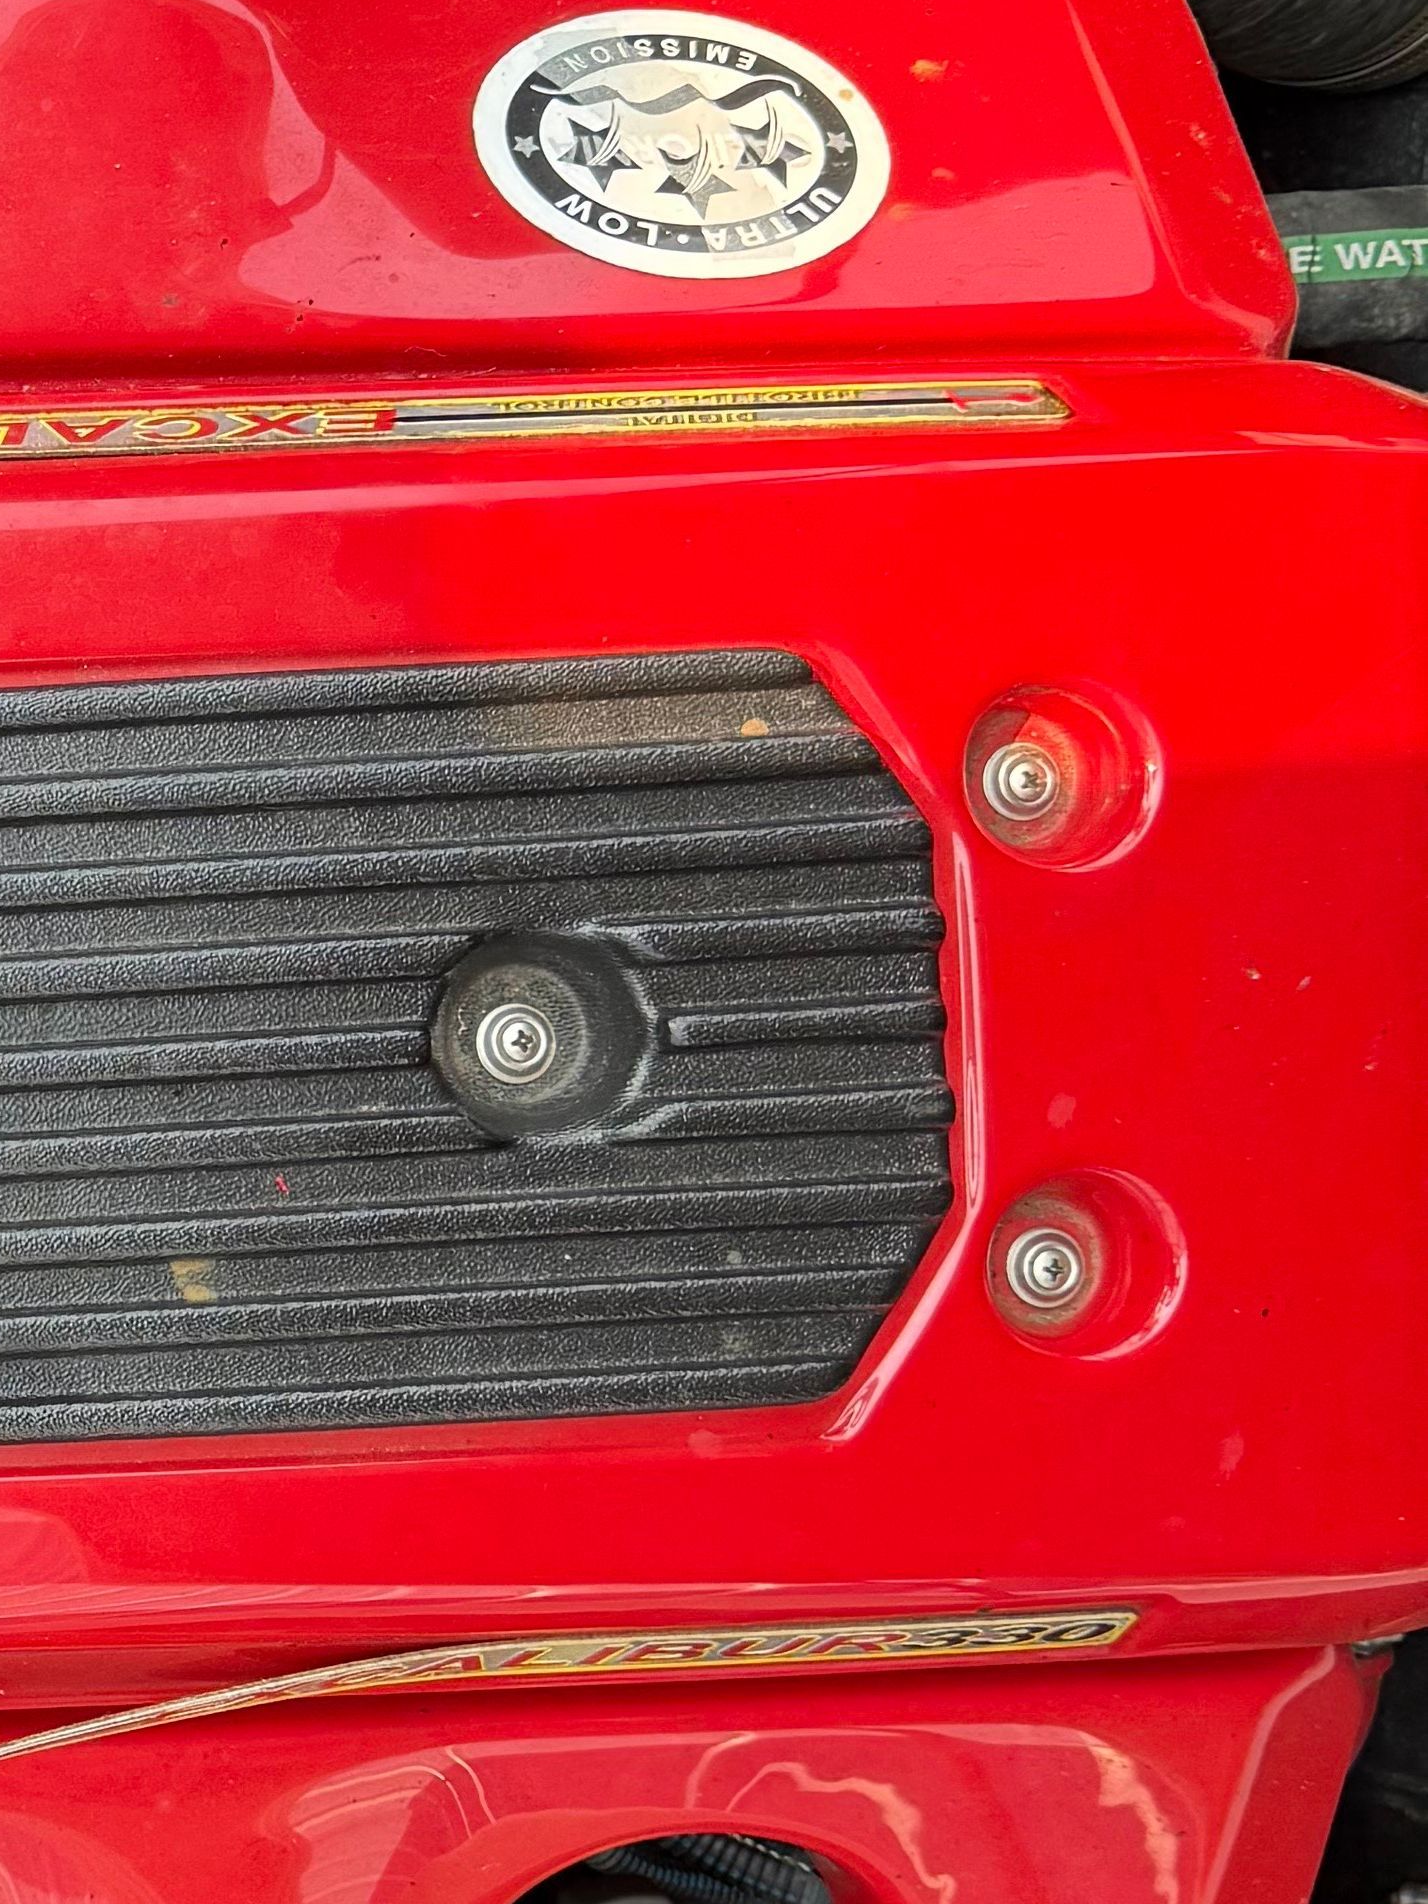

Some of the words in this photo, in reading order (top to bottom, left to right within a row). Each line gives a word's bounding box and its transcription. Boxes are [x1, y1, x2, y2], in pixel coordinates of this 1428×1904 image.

[564, 36, 759, 74] EMISSION
[554, 194, 660, 248] LOW
[704, 183, 844, 251] ULTRA
